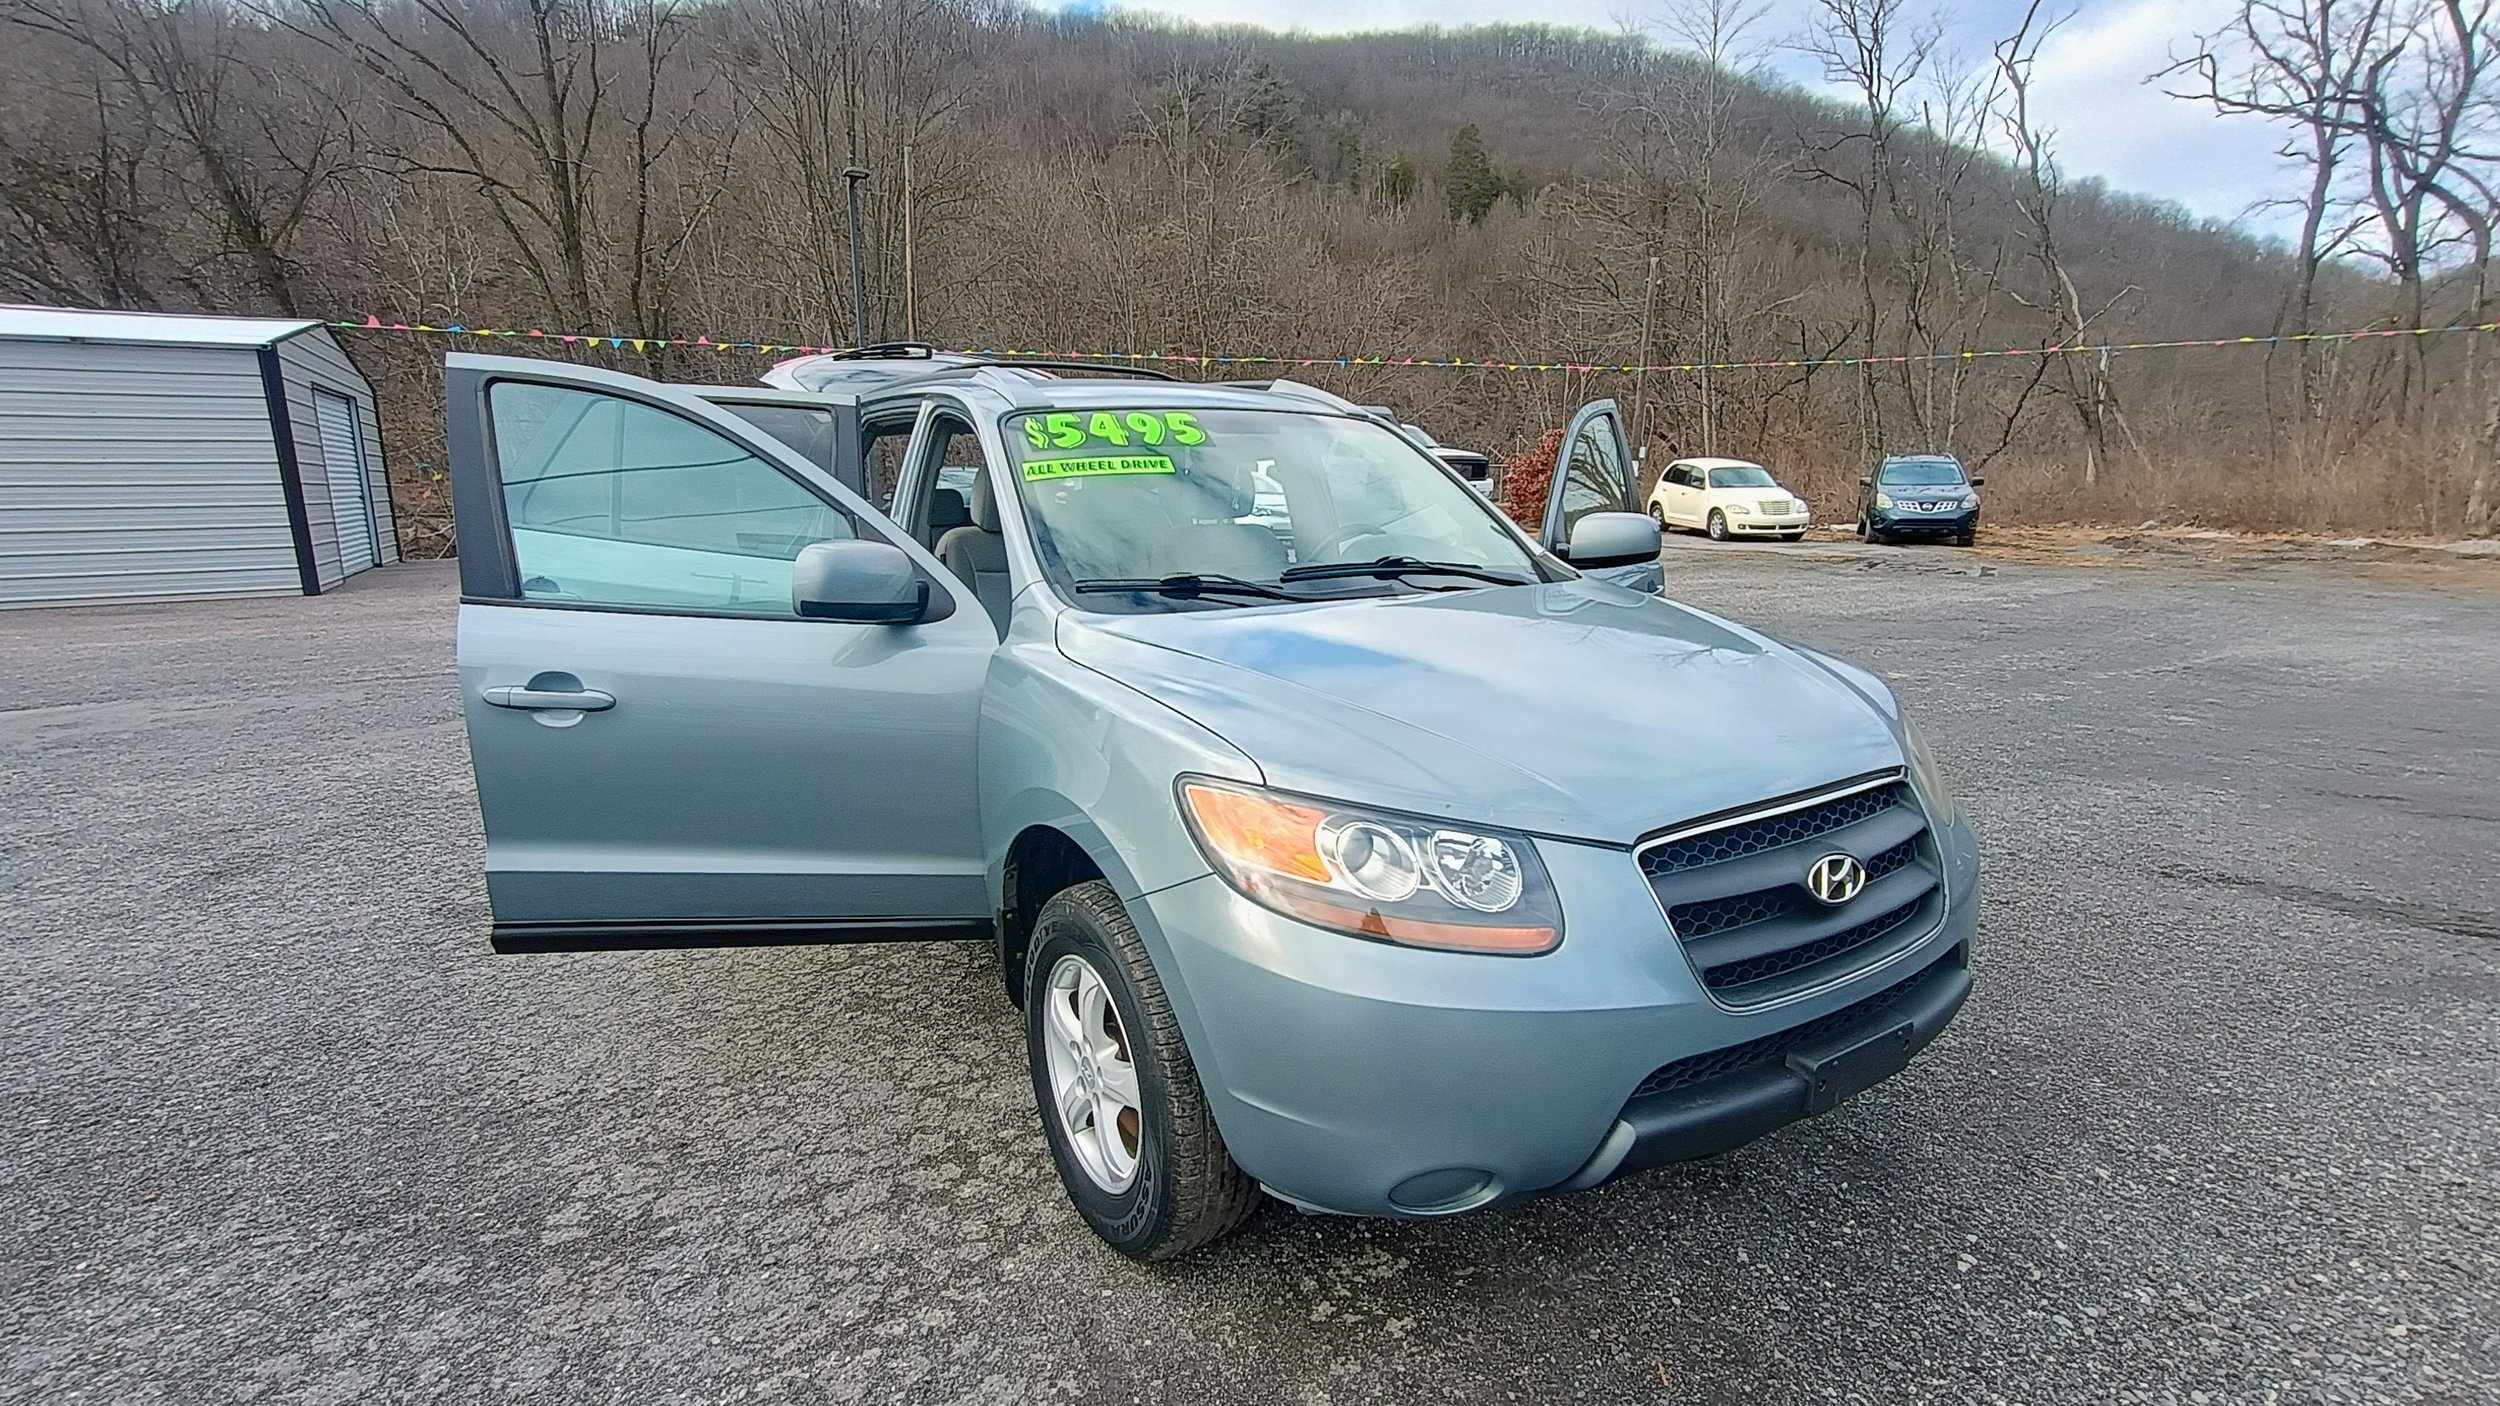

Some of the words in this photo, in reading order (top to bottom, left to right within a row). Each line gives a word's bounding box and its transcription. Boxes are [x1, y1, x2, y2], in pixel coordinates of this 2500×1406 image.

[1023, 411, 1206, 449] $5495
[1026, 462, 1055, 477] ALL
[1059, 459, 1117, 472] WHEEL
[1121, 458, 1169, 471] DRIVE
